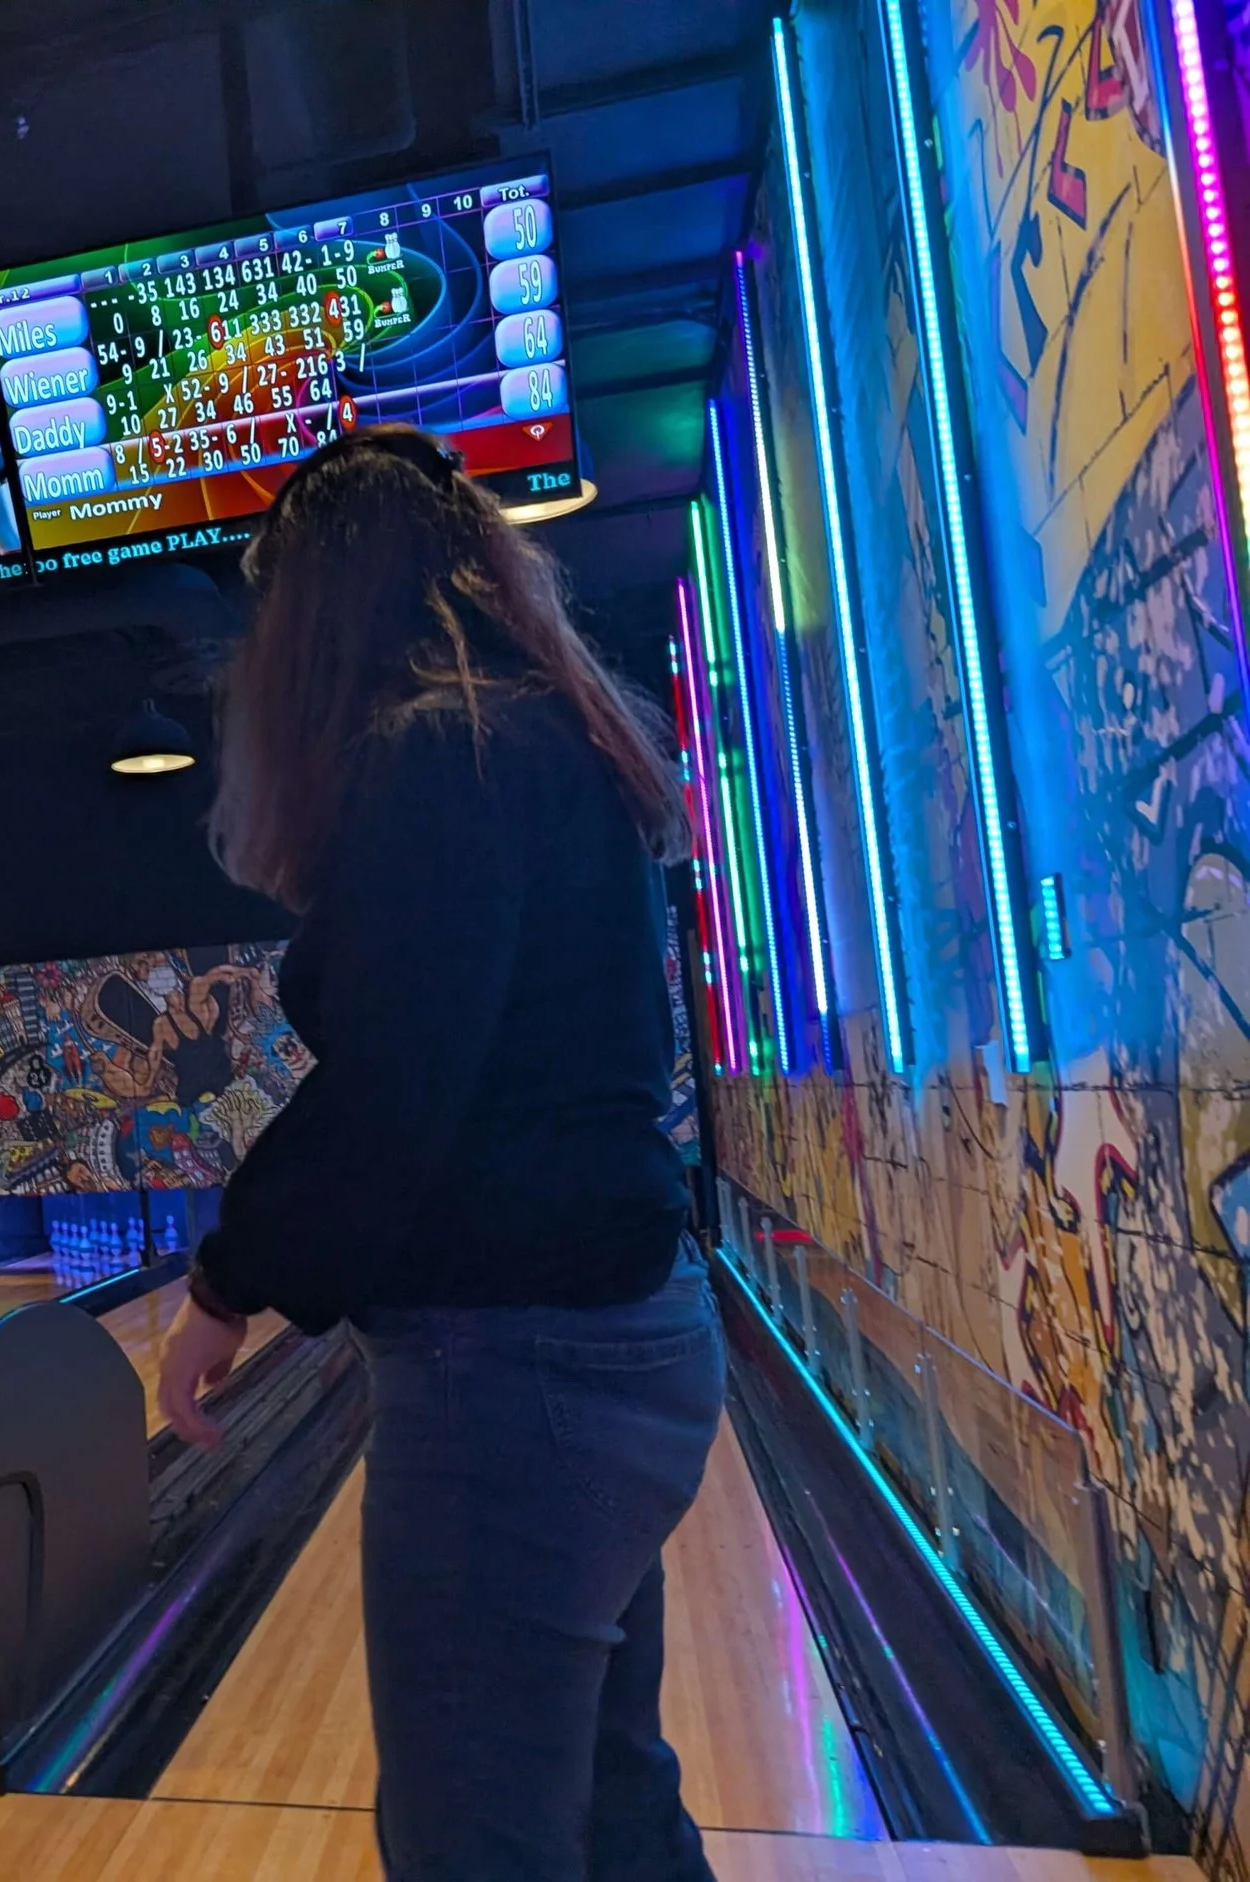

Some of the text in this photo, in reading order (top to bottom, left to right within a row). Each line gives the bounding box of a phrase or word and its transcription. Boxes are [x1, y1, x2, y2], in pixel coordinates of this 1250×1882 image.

[104, 271, 113, 285] 1
[142, 262, 151, 277] 2
[180, 255, 190, 269] 3
[219, 247, 229, 260] 4
[259, 239, 269, 252] 5
[298, 230, 308, 243] 6
[337, 221, 347, 235] 7
[380, 212, 390, 227] 8
[421, 203, 432, 218] 9
[453, 194, 473, 211] 10
[499, 185, 530, 202] Tot.
[113, 205, 538, 334] 0 8 16 24 34 40 50 50
[165, 272, 197, 298] 143
[202, 264, 235, 290] 134
[241, 256, 274, 283] 631
[122, 260, 543, 385] 9 21 26 34 43 51 59 59
[250, 310, 282, 336] 333
[289, 301, 322, 328] 332
[3, 366, 89, 405] Wiener
[121, 315, 548, 437] 10 27 34 46 55 64 64
[296, 354, 329, 380] 216
[129, 463, 150, 485] 15
[166, 456, 187, 479] 22
[203, 451, 223, 472] 30
[240, 443, 262, 465] 50
[278, 436, 300, 458] 70
[528, 368, 553, 412] 84
[341, 403, 353, 423] 4
[13, 415, 87, 455] Daddy
[23, 465, 105, 502] Momm
[527, 472, 571, 492] The
[32, 493, 163, 521] Player Mommy
[63, 552, 102, 570] free
[109, 540, 162, 564] game
